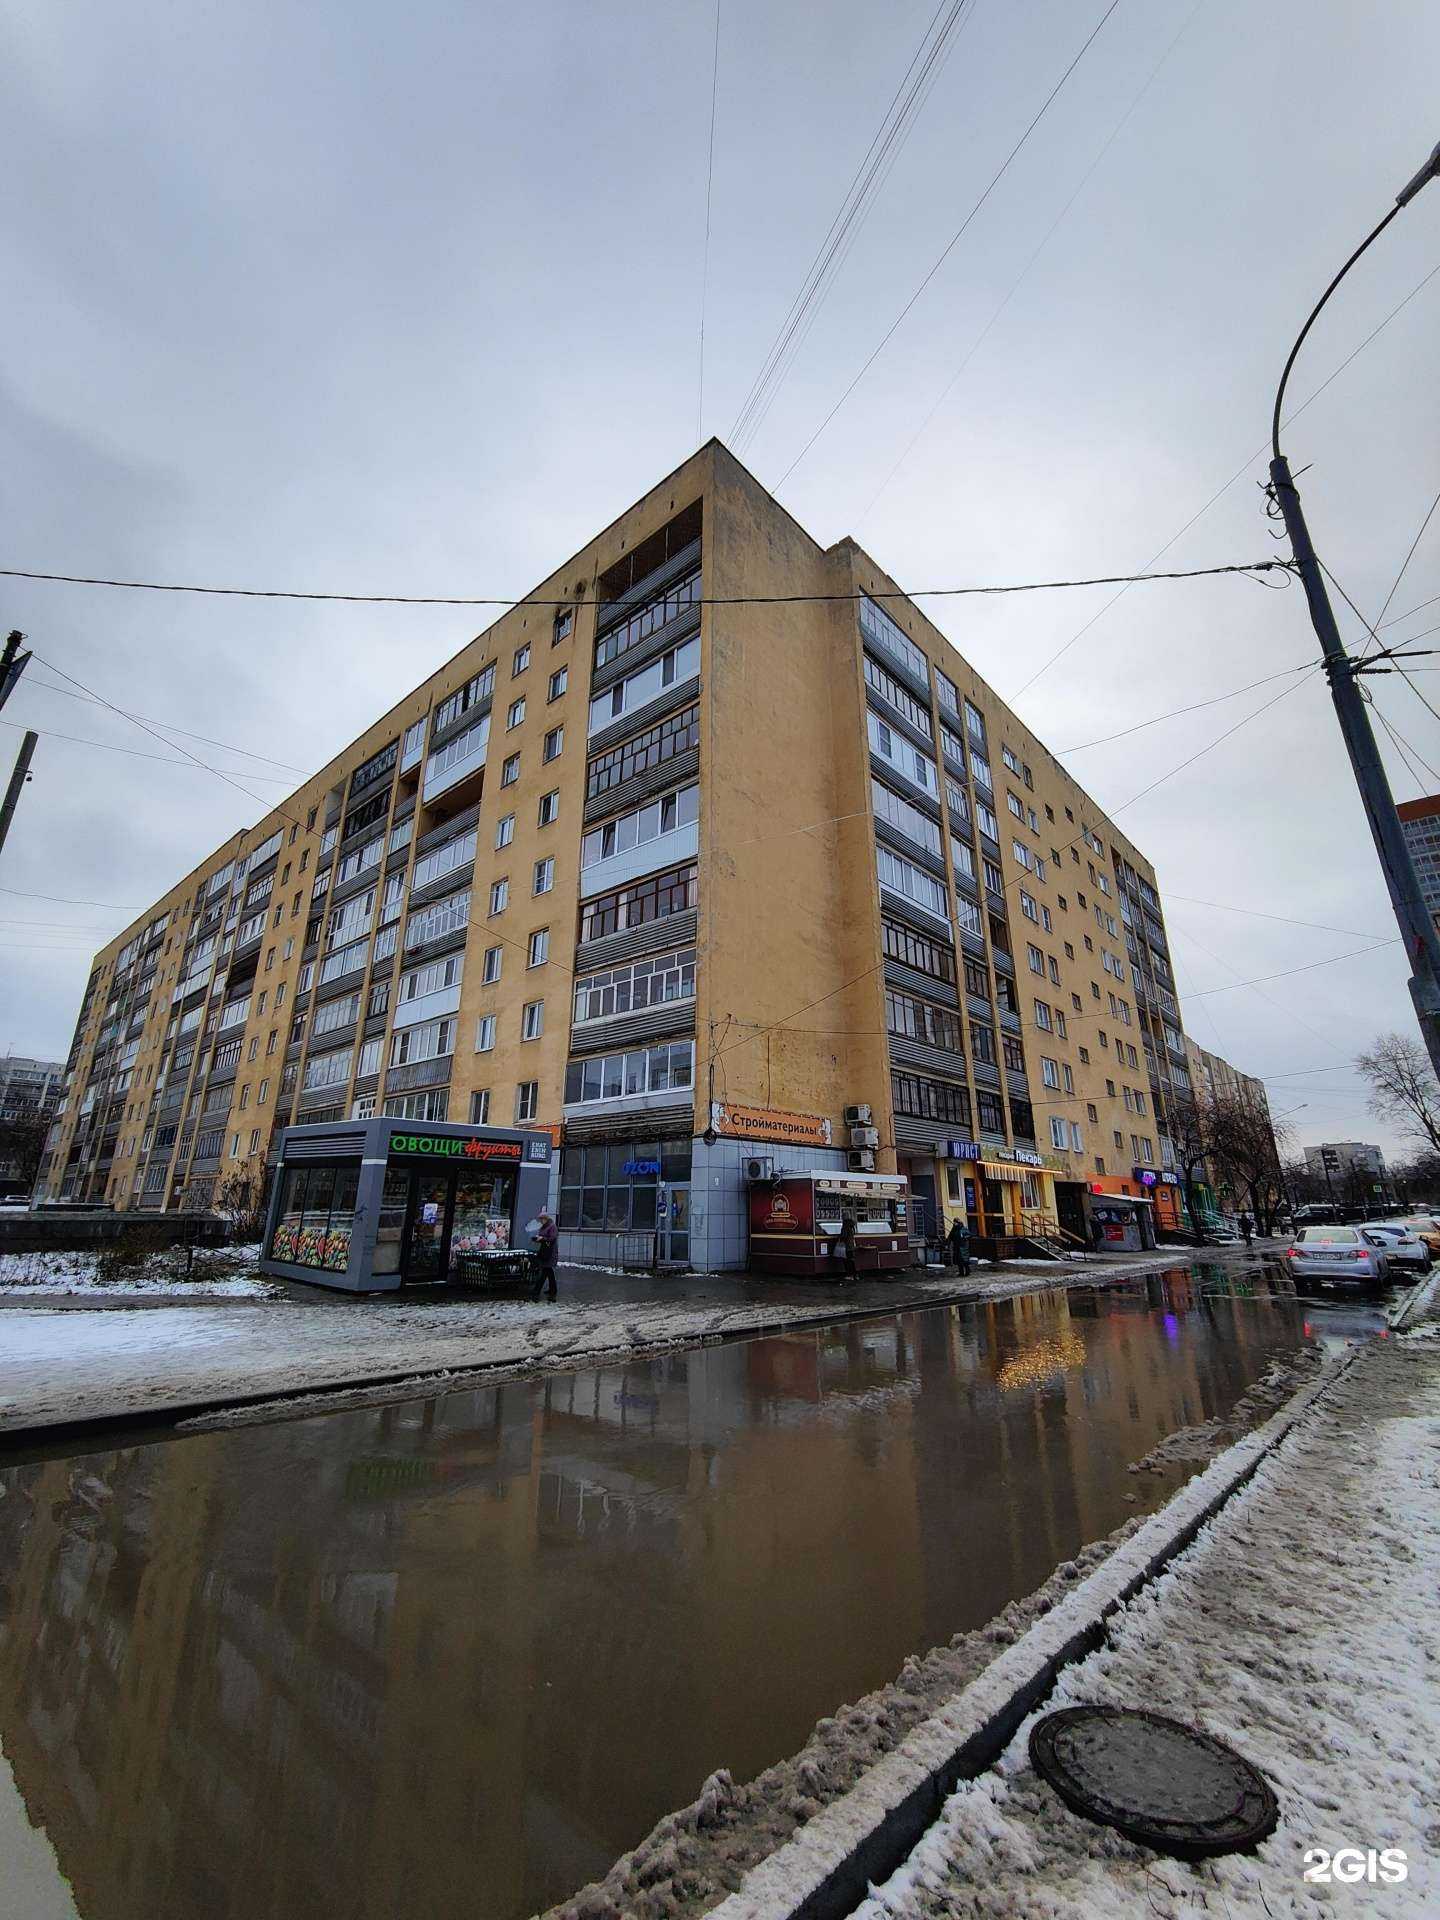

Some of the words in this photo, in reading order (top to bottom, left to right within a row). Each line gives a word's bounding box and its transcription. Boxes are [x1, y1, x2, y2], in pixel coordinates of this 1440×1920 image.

[731, 1113, 817, 1136] Стройматериалы
[392, 1135, 462, 1157] ОВОЩИ
[464, 1136, 521, 1161] фрукты
[953, 1141, 978, 1159] ЮРИСТ
[1015, 1149, 1042, 1167] Пекарь
[624, 1161, 660, 1175] OZON
